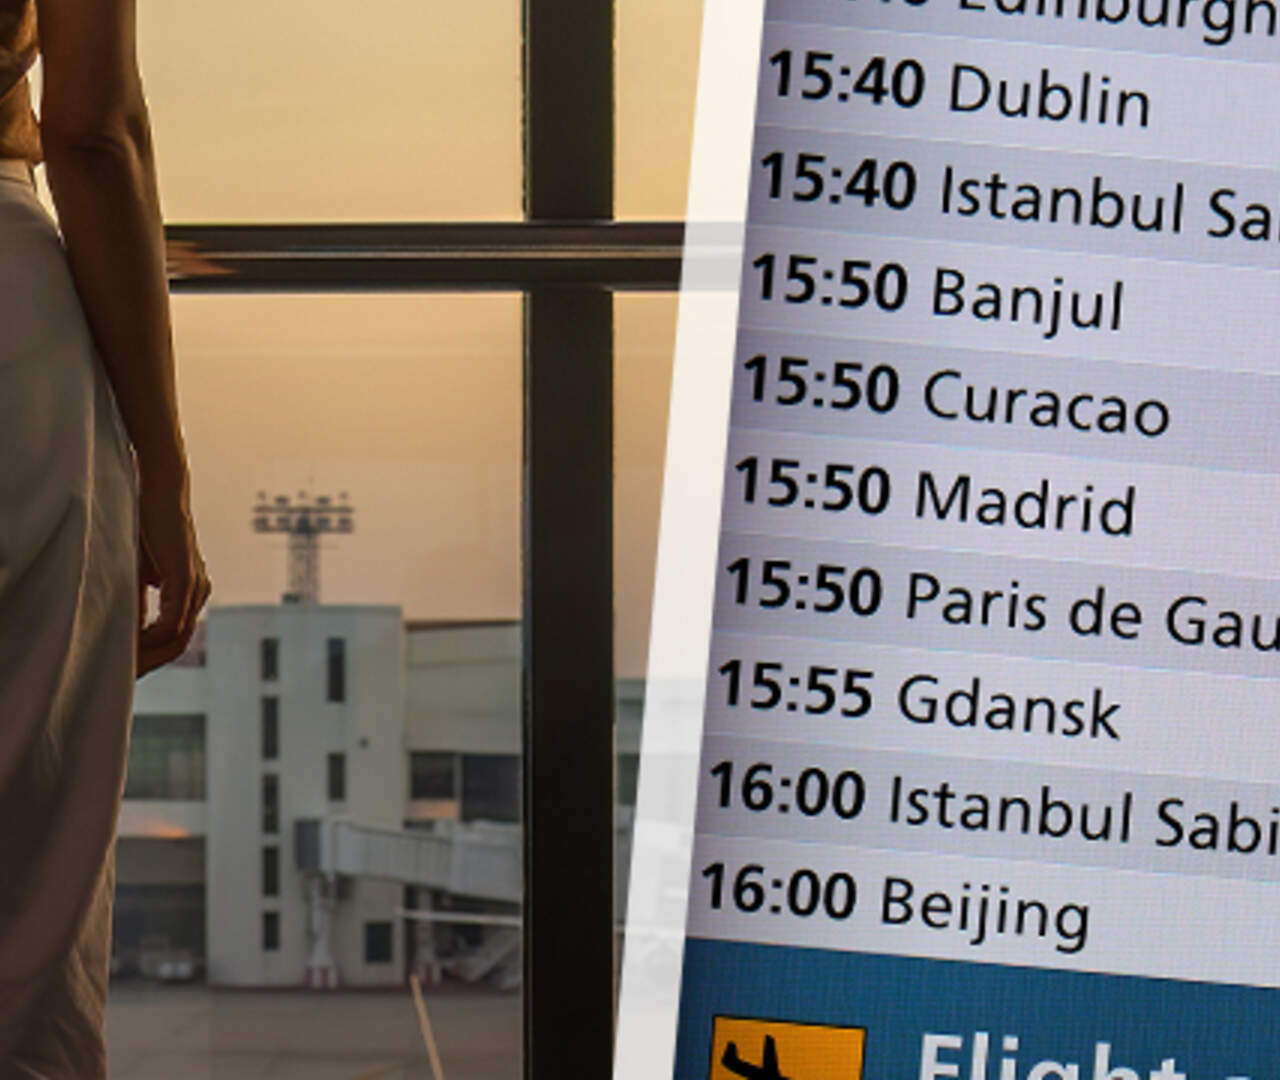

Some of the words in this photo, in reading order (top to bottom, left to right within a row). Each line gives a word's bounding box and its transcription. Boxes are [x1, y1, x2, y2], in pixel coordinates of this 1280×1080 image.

[767, 48, 926, 109] 15:40
[949, 63, 1150, 128] Dublin
[759, 150, 918, 211] 15:40
[941, 165, 1185, 234] Istanbul
[751, 252, 909, 312] 15:50
[932, 267, 1124, 340] Banjul
[742, 353, 900, 414] 15:50
[923, 369, 1170, 438] Curacao
[734, 454, 892, 516] 15:50
[915, 470, 1136, 536] Madrid
[725, 556, 883, 617] 15:50
[906, 571, 1047, 632] Paris
[1068, 585, 1143, 640] de
[717, 658, 874, 719] 15:55
[897, 673, 1121, 740] Gdansk
[708, 759, 867, 821] 16:00
[889, 775, 1133, 844] Istanbul
[700, 860, 858, 921] 16:00
[881, 876, 1089, 955] Beijing
